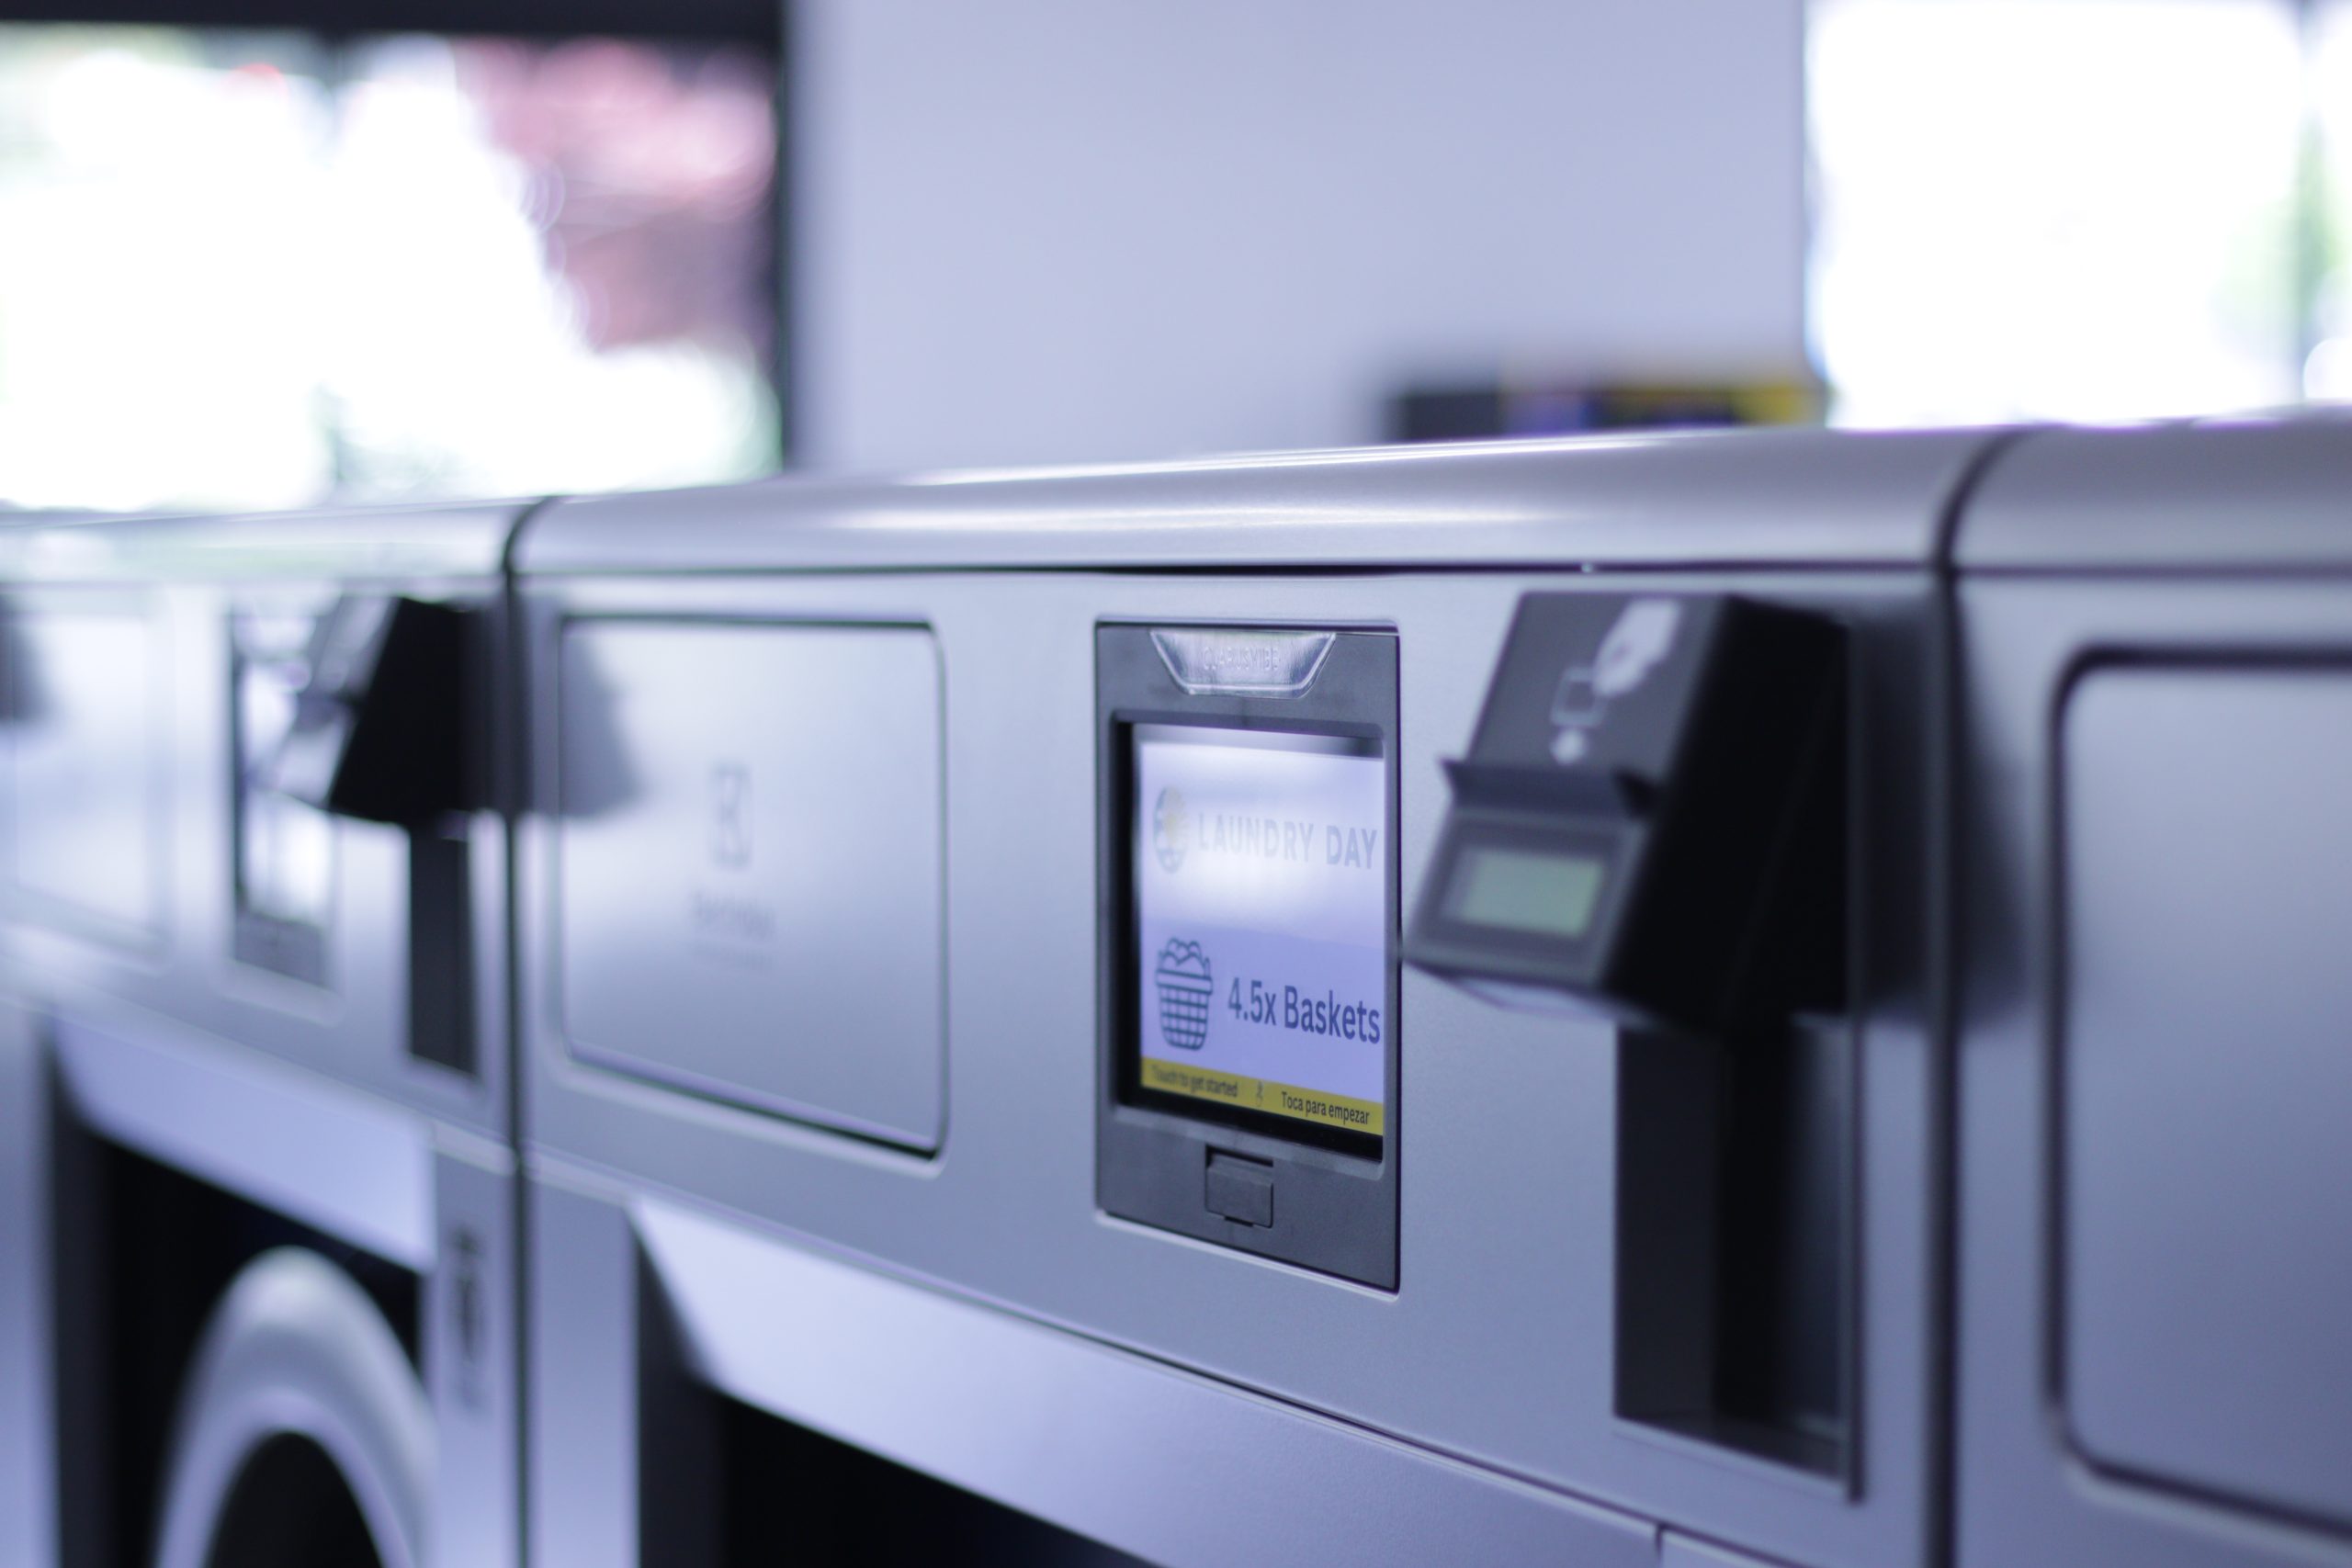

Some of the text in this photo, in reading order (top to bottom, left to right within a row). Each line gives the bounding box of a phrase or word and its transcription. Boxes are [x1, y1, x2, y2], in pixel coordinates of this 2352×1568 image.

[1198, 812, 1377, 870] LAUNDRY DAY
[1227, 976, 1381, 1044] 4.5x Baskets
[1180, 1071, 1189, 1086] to
[1191, 1074, 1204, 1093] get
[1206, 1077, 1238, 1099] started
[1281, 1090, 1371, 1125] Toca para empezar
